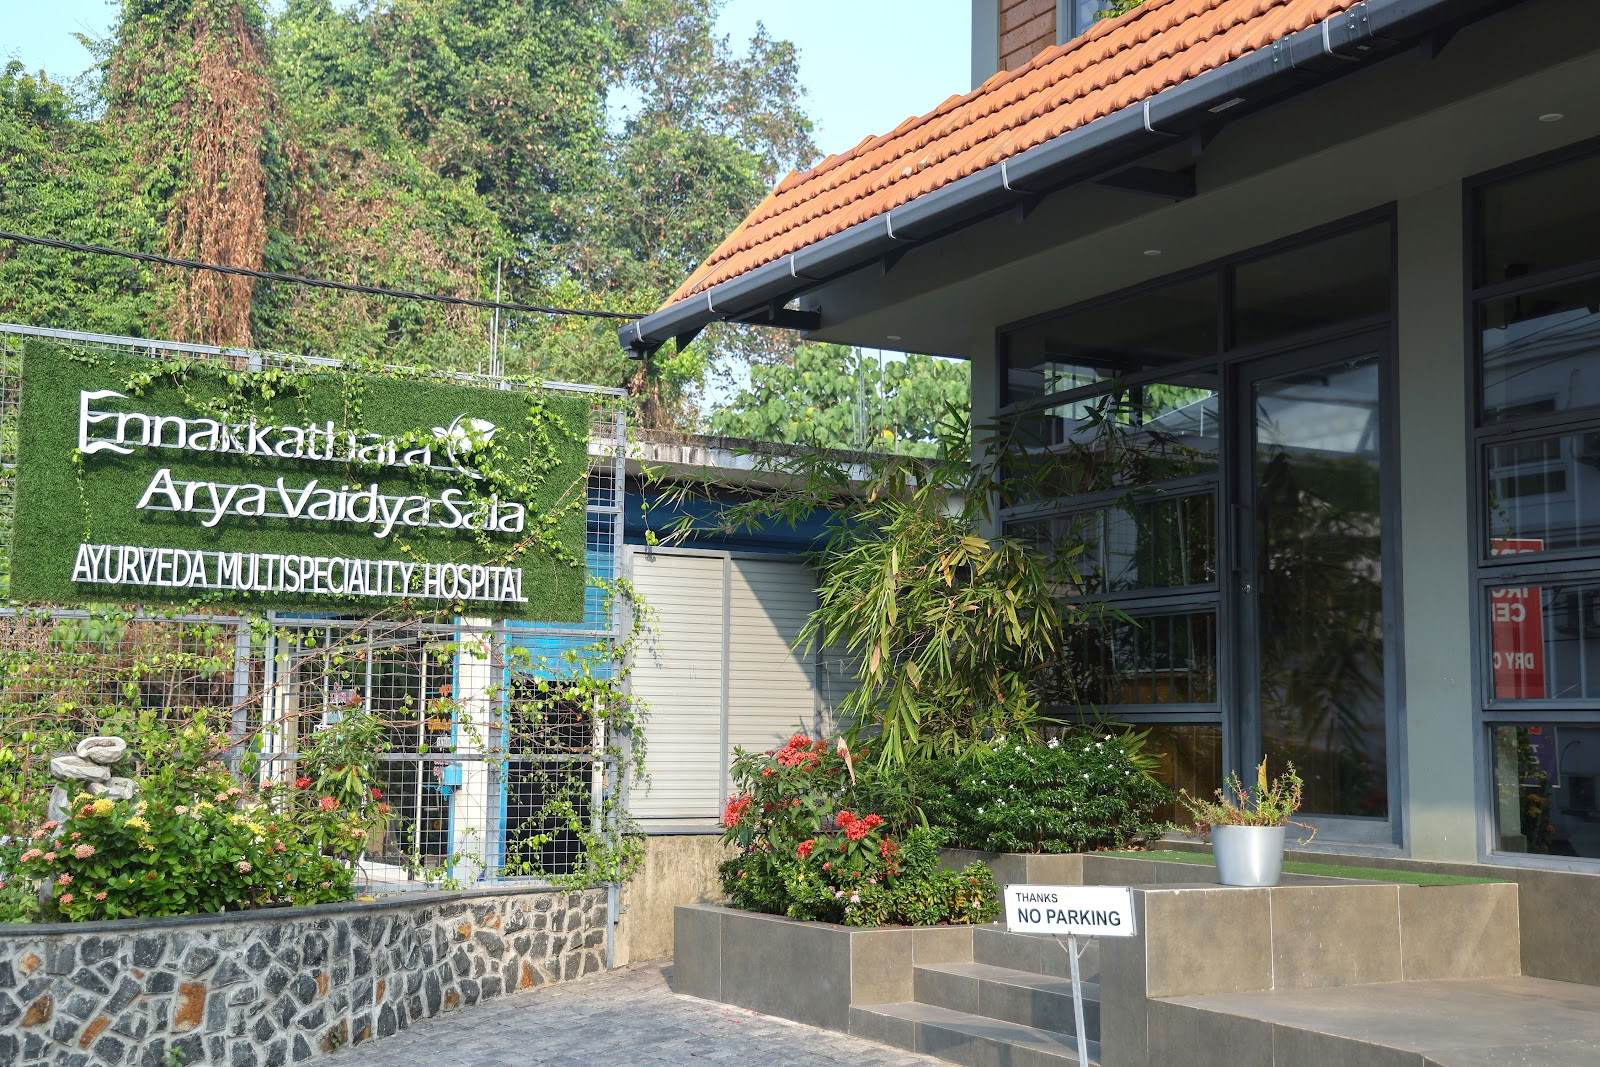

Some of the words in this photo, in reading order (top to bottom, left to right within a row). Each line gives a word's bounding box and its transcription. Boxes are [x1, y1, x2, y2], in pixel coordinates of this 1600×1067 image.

[136, 468, 265, 527] Arya
[277, 477, 430, 538] Vaidya
[439, 488, 525, 532] Sala
[71, 543, 207, 588] AYURVEDA
[218, 552, 415, 596] MULTISPECIALITY
[424, 562, 529, 602] HOSPITAL
[1016, 892, 1058, 903] THANKS
[1018, 908, 1041, 923] NO
[1046, 909, 1121, 926] PARKING
